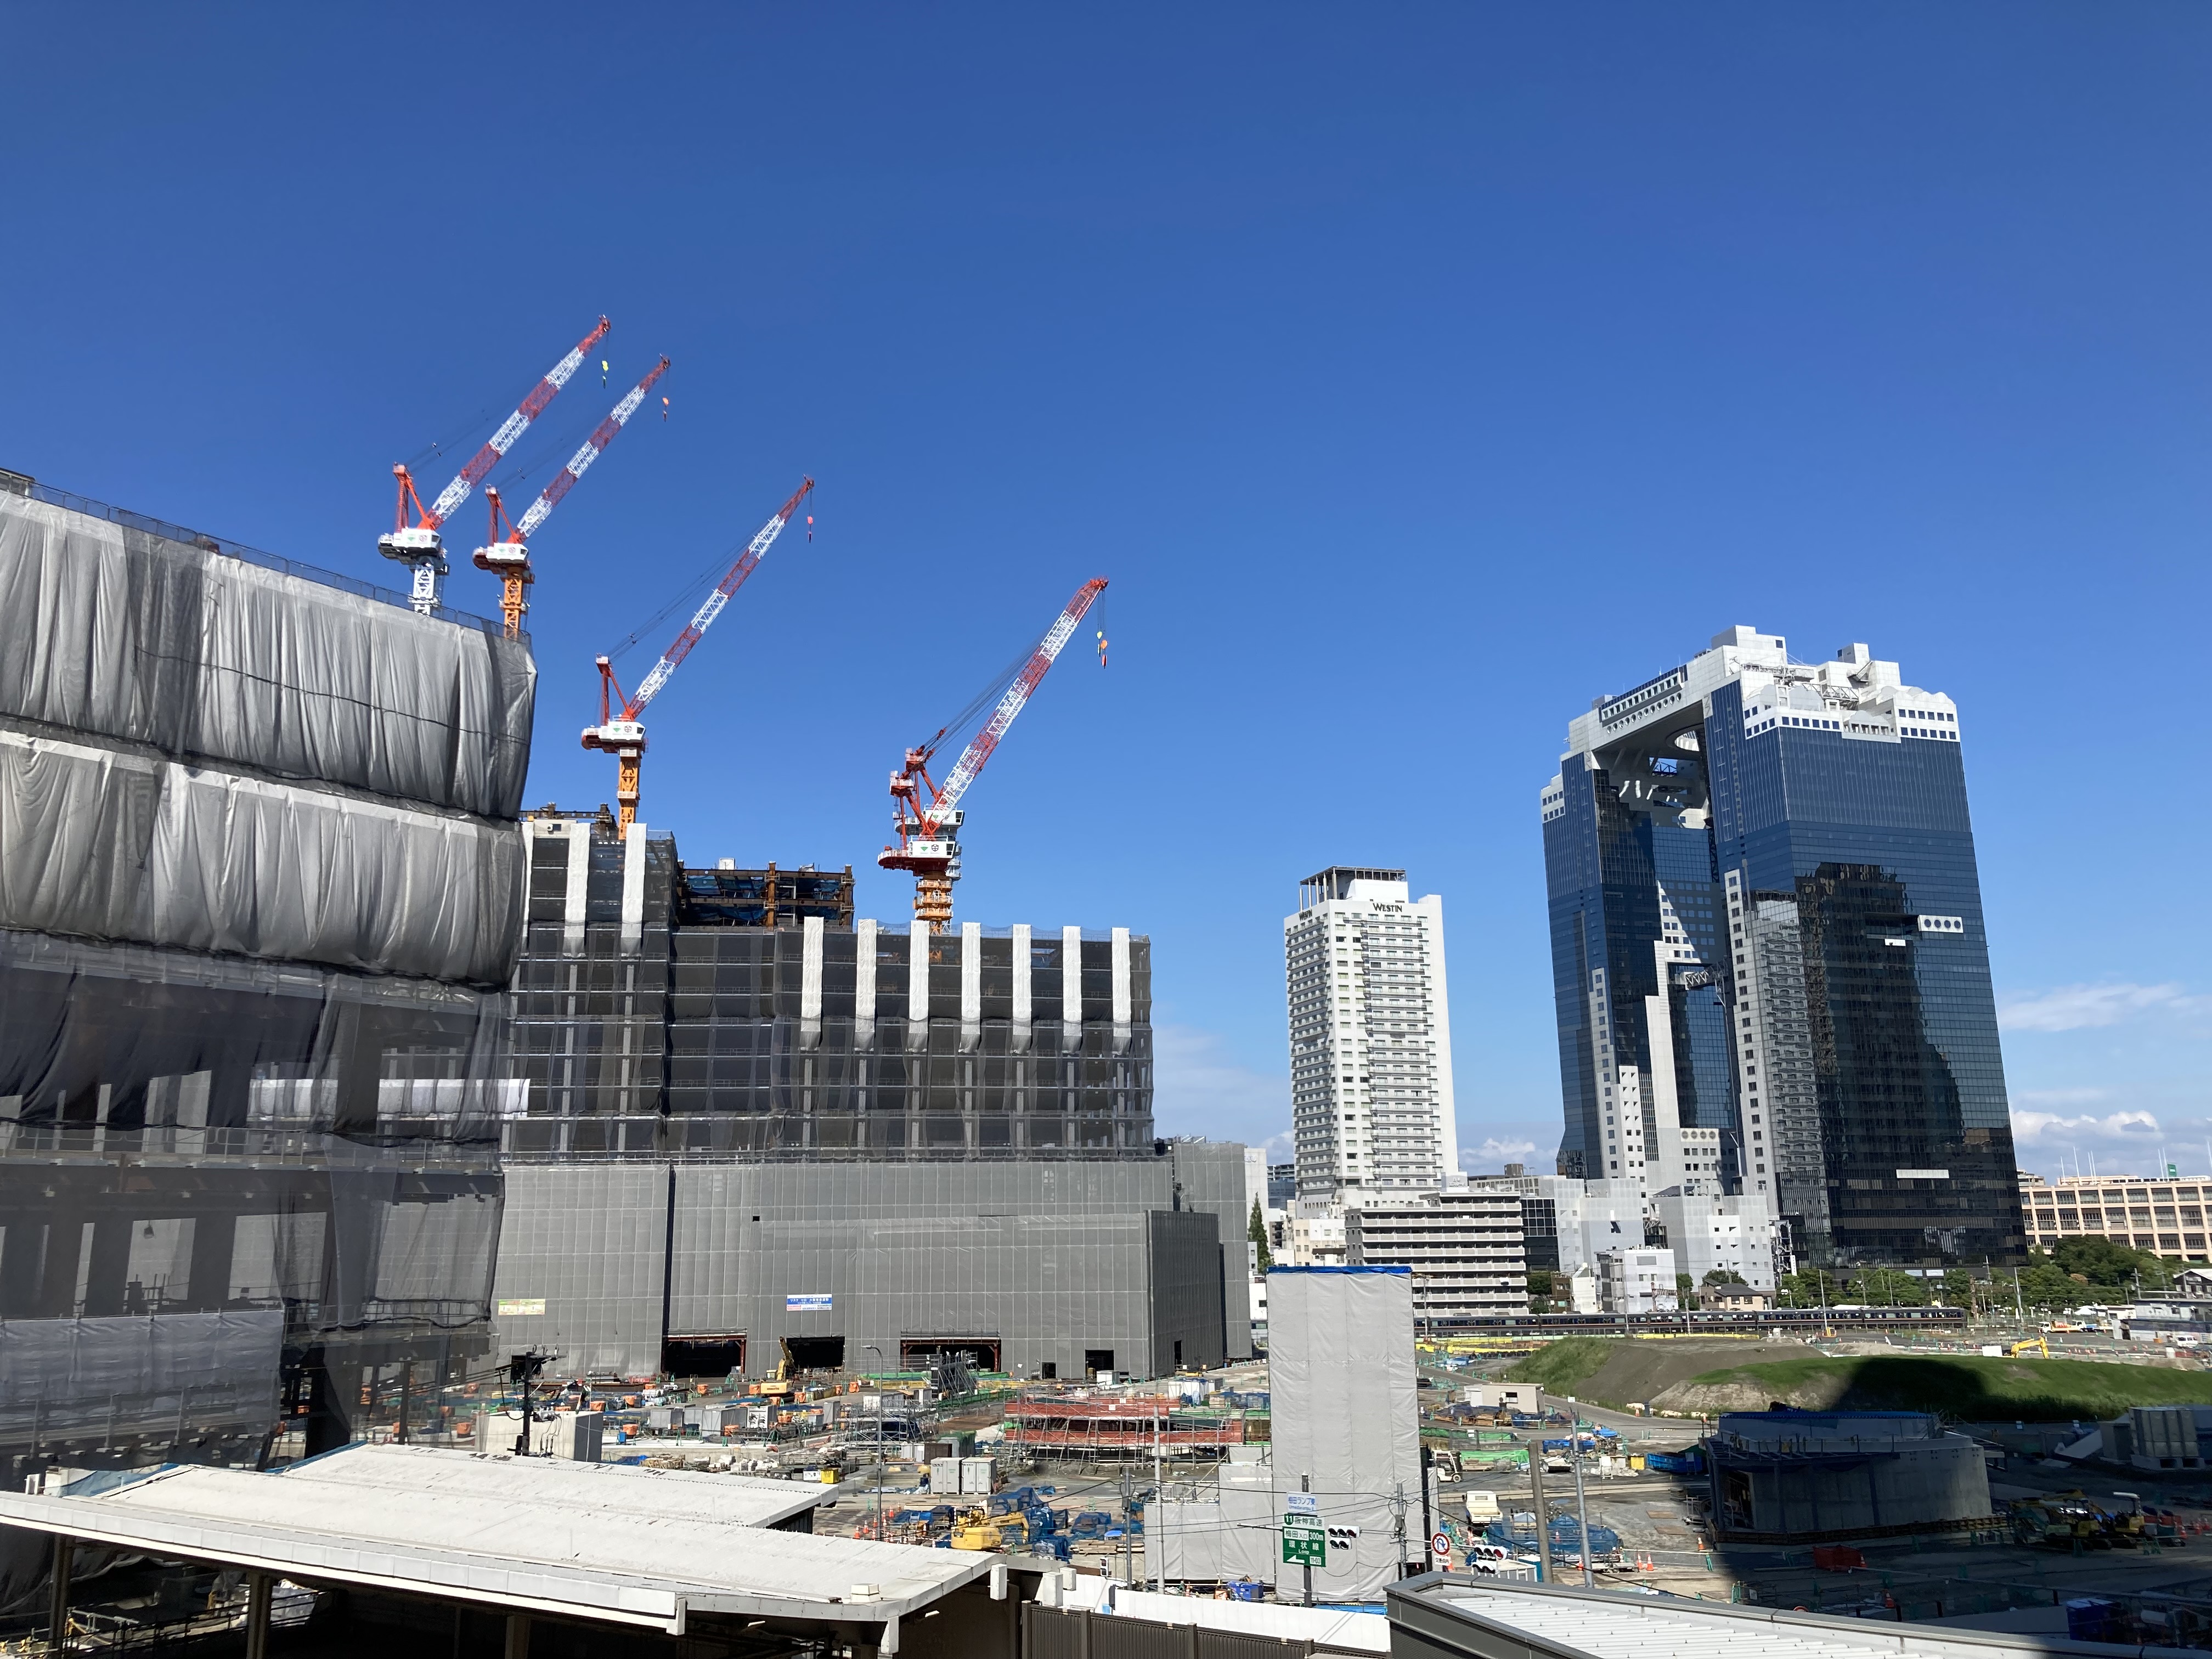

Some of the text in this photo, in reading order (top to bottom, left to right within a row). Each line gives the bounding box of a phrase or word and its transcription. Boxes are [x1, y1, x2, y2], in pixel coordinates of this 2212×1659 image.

[1295, 1516, 1323, 1527] 阪神高速
[1309, 1532, 1324, 1541] 300m
